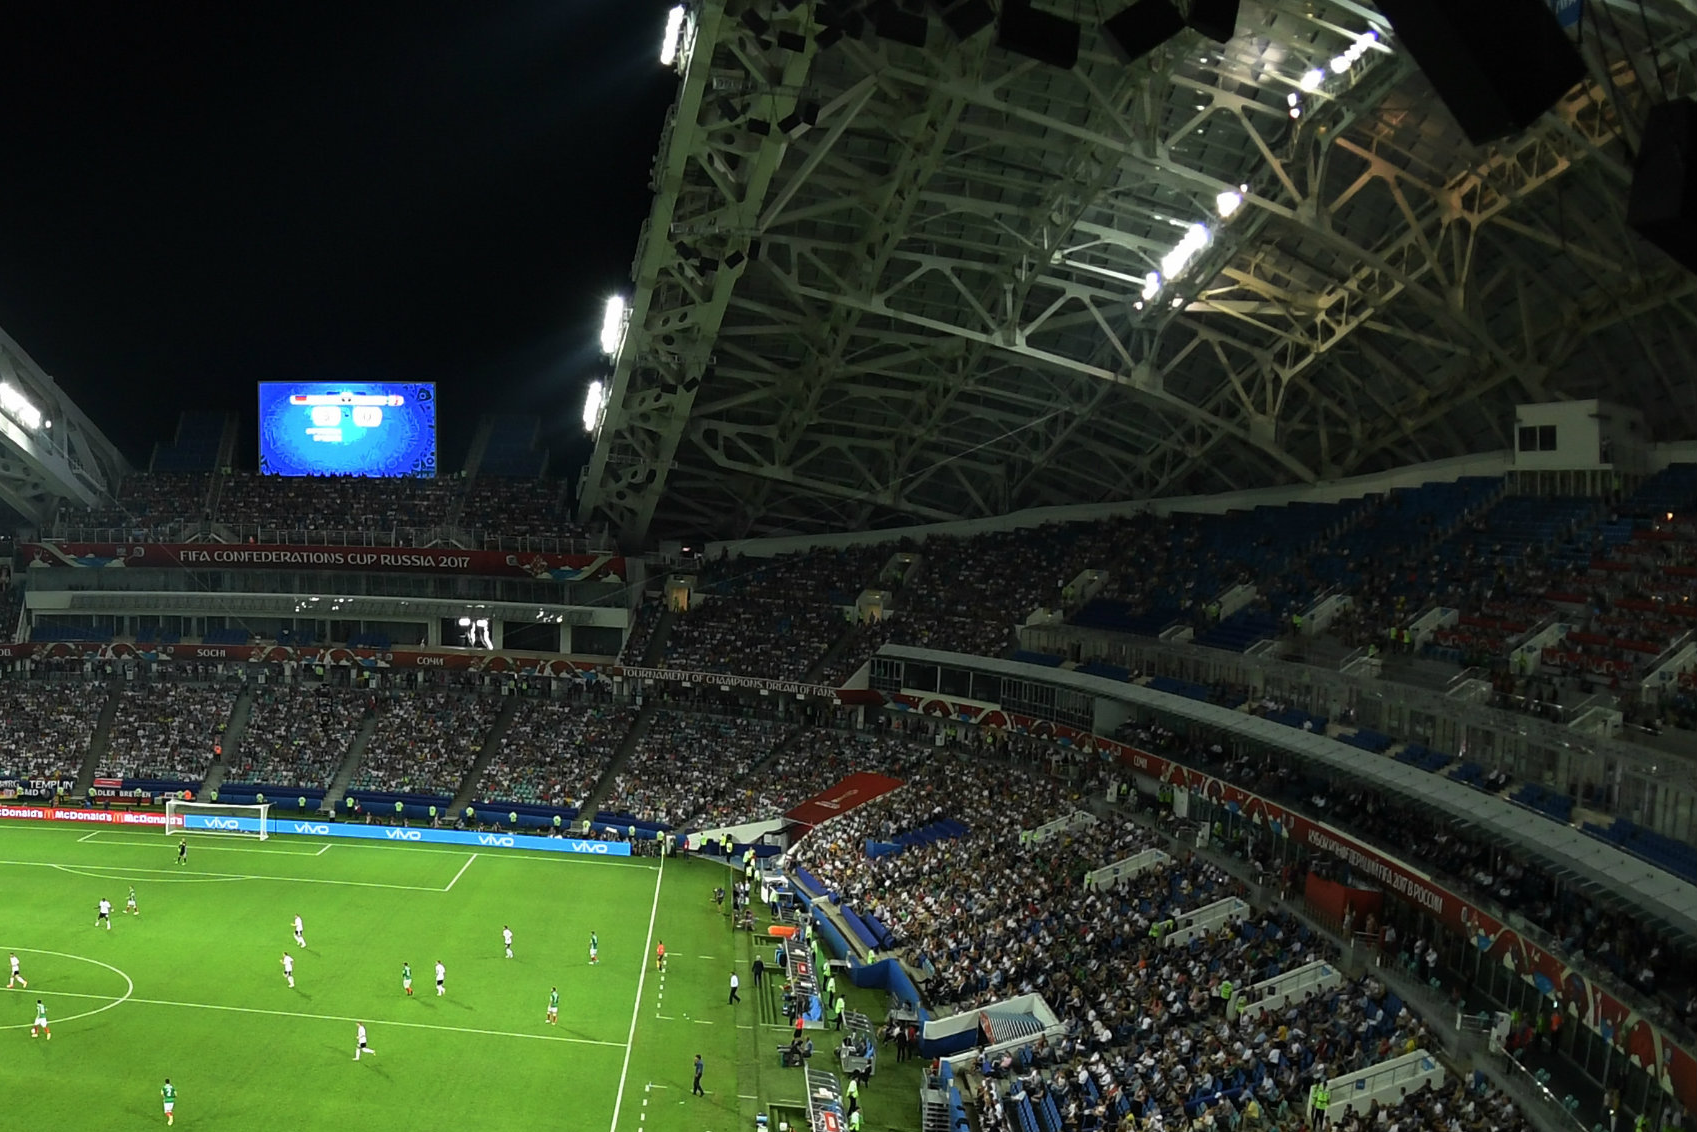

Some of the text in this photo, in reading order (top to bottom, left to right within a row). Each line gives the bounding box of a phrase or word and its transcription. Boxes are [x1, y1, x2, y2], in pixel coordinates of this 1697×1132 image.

[180, 550, 470, 568] FIFA CONFEDERATIONS CUP RUSSIA 2017
[197, 648, 226, 658] SOCHI
[416, 655, 444, 666] СОЧИ
[622, 668, 690, 682] TOURNAMENT
[692, 674, 704, 682] OF
[766, 682, 798, 694] DREAM
[798, 686, 812, 695] OF
[30, 780, 74, 790] TEMPLIN
[55, 810, 112, 822] McDonald's
